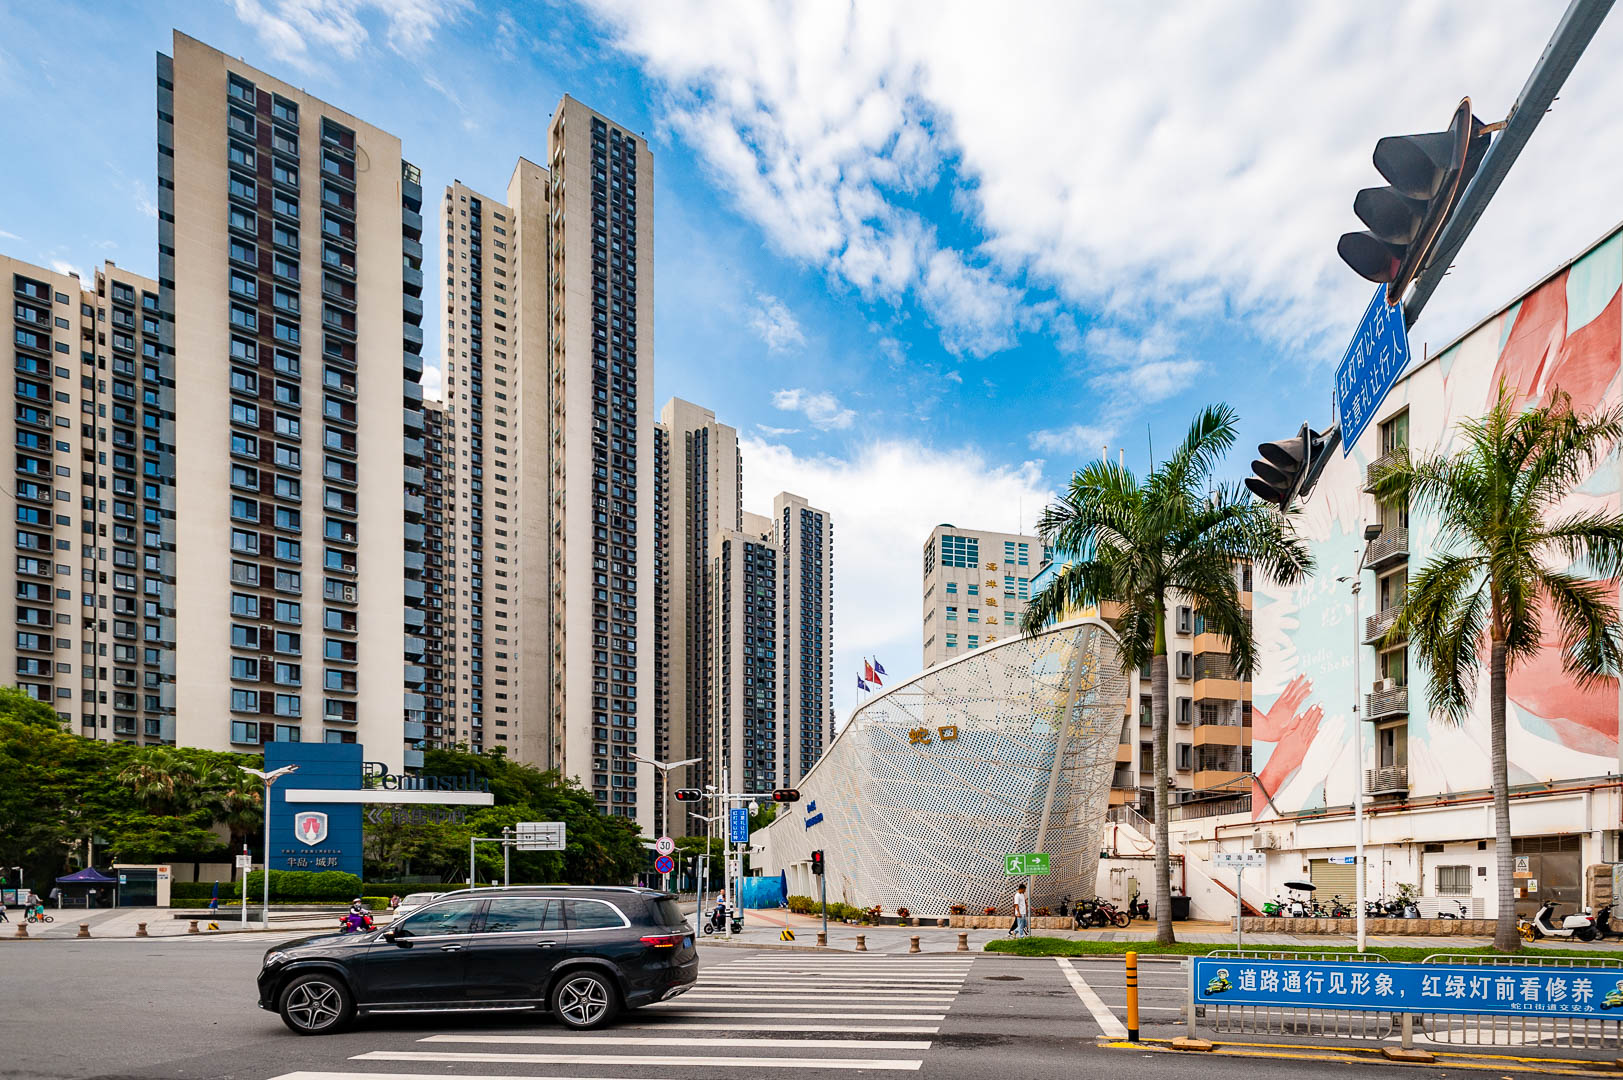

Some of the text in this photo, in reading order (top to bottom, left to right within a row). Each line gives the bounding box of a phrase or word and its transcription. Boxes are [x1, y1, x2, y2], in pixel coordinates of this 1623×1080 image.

[1344, 330, 1403, 439] 注意礼让行人
[909, 726, 958, 745] 蛇口
[361, 761, 490, 793] Peninsula
[660, 841, 671, 850] 30
